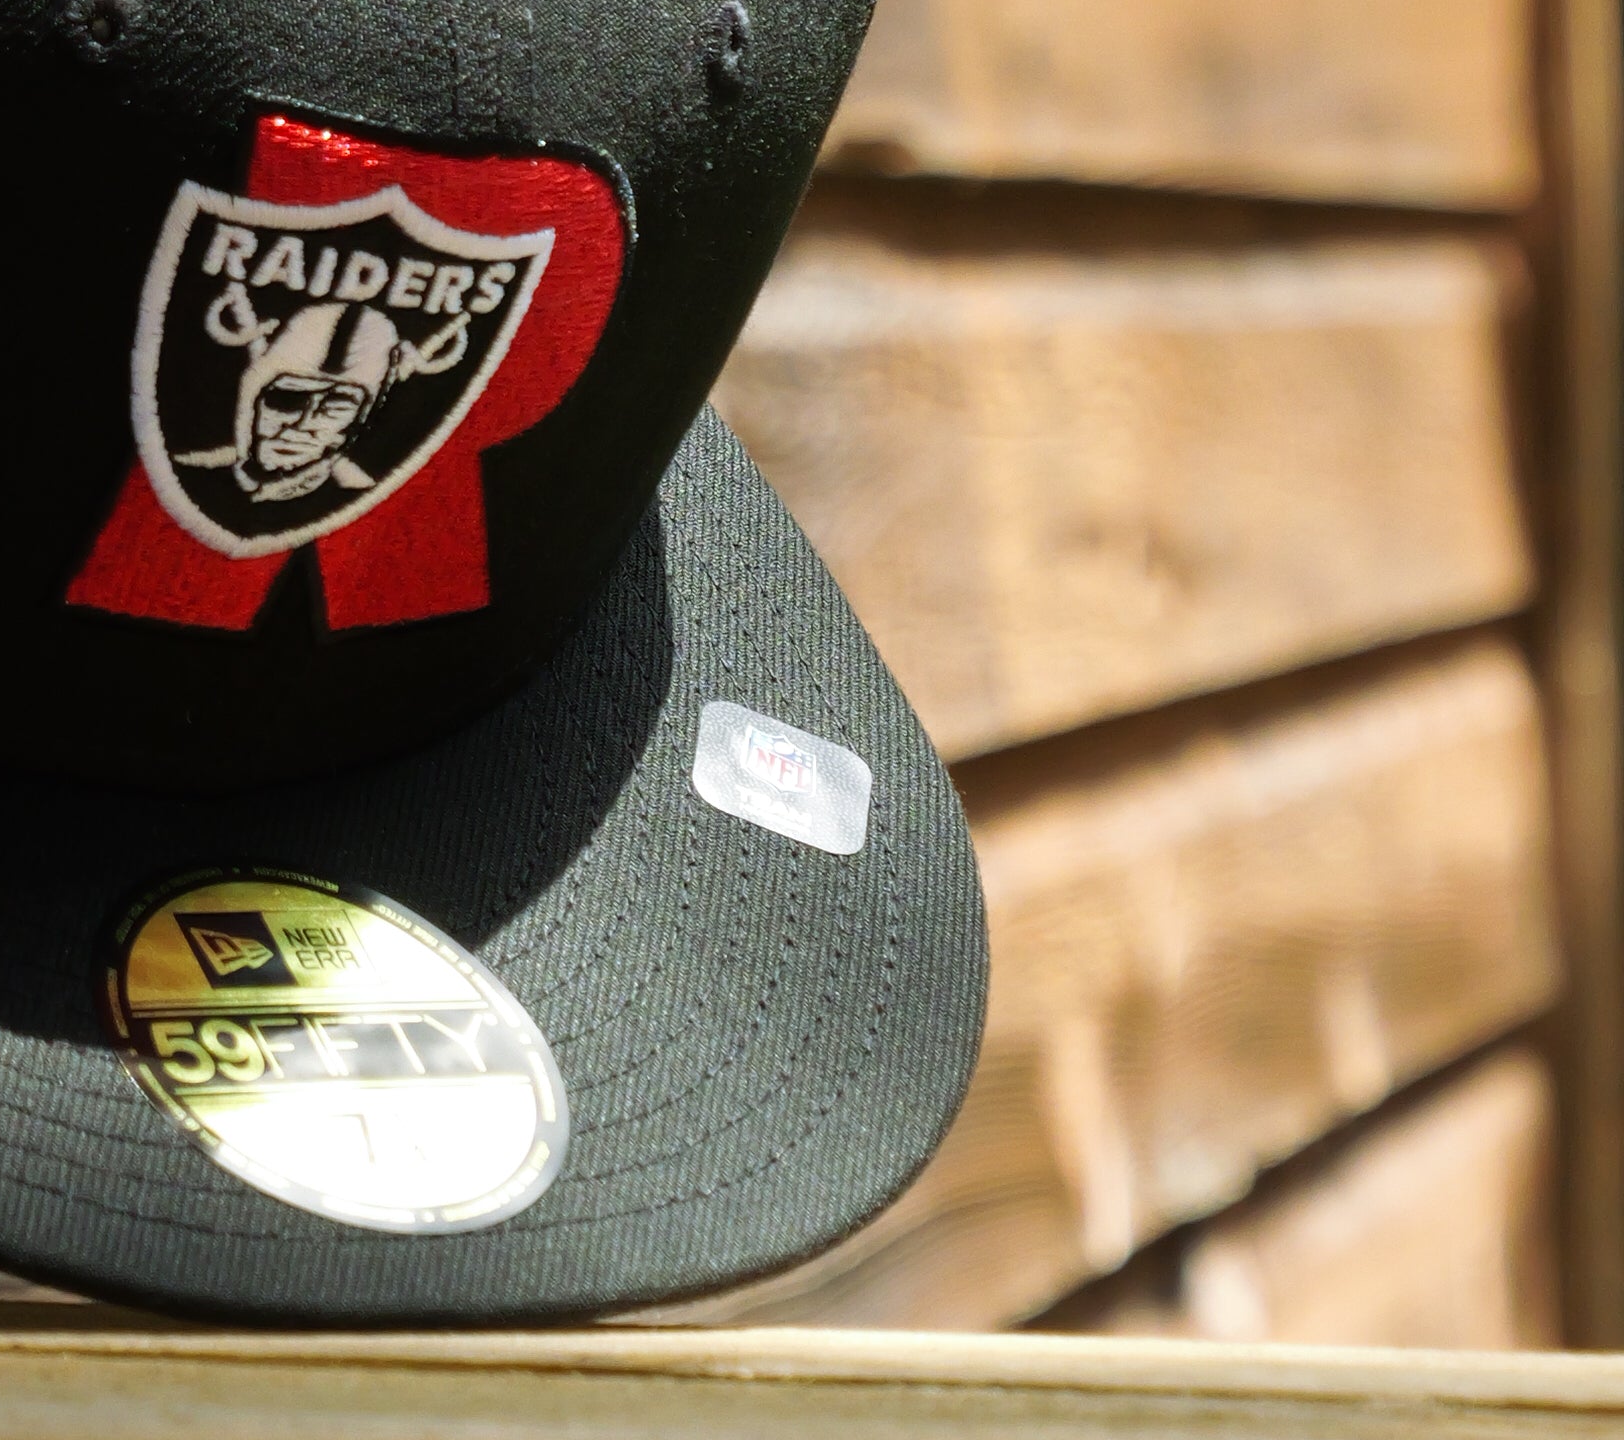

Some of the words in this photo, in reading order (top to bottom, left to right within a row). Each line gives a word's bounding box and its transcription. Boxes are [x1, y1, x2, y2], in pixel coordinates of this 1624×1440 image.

[201, 224, 515, 314] RAIDERS
[756, 747, 812, 790] NFL
[283, 926, 347, 947] NEW
[300, 949, 360, 971] ERA
[151, 1014, 488, 1084] 59FIFTY
